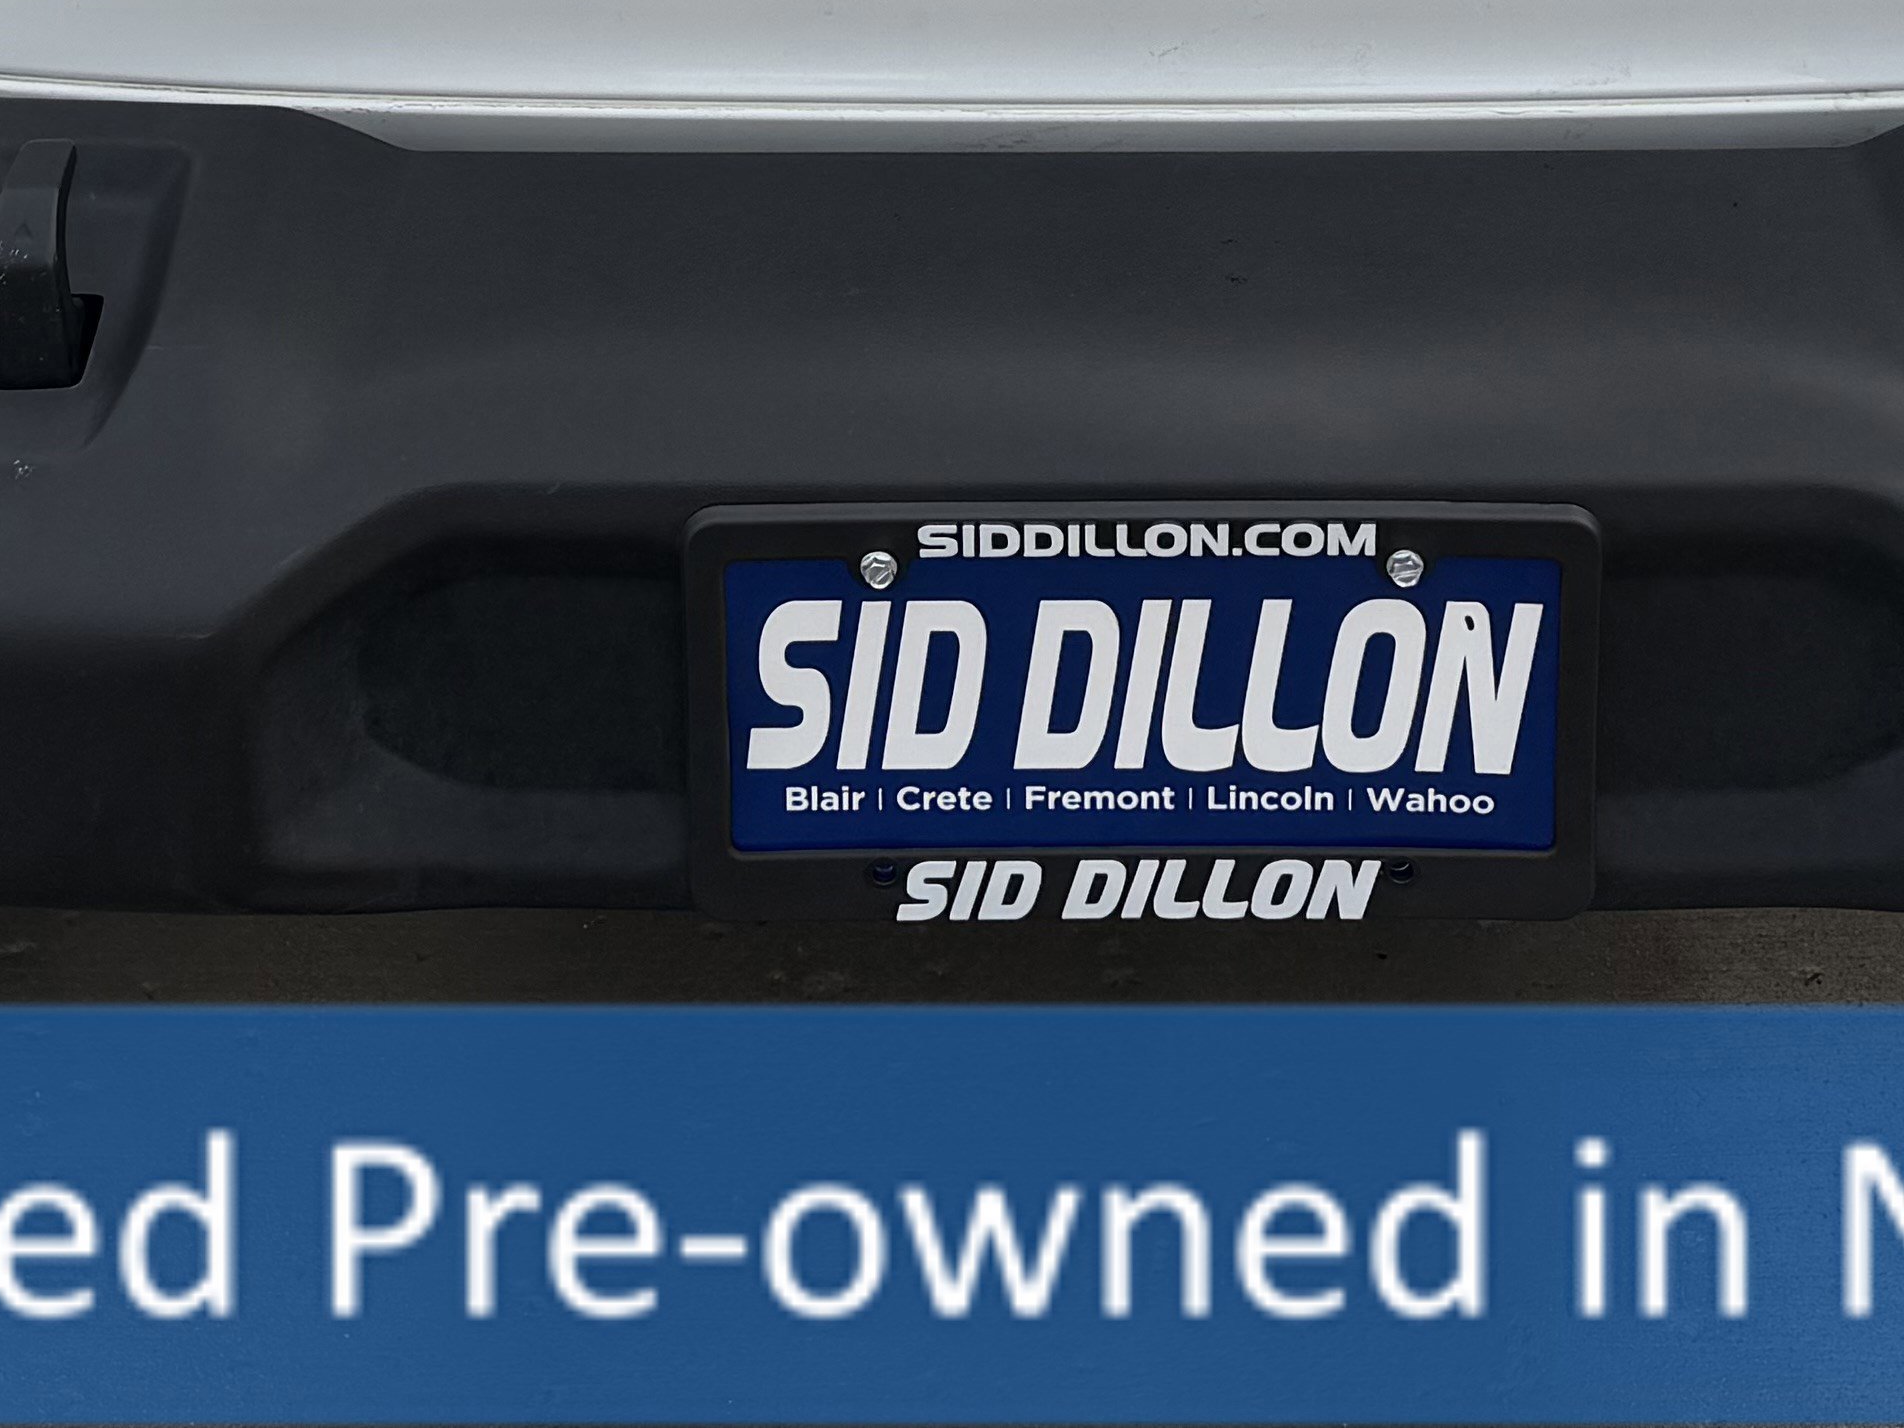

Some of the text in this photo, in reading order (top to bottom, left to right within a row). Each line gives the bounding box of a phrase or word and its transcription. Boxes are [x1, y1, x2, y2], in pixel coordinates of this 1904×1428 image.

[917, 522, 1377, 558] SIDDILLON.COM
[746, 598, 1544, 775] SID DILLON
[785, 784, 1495, 814] Blair Crete Fremont Lincoln Wahoo
[896, 858, 1382, 922] SID DILLON
